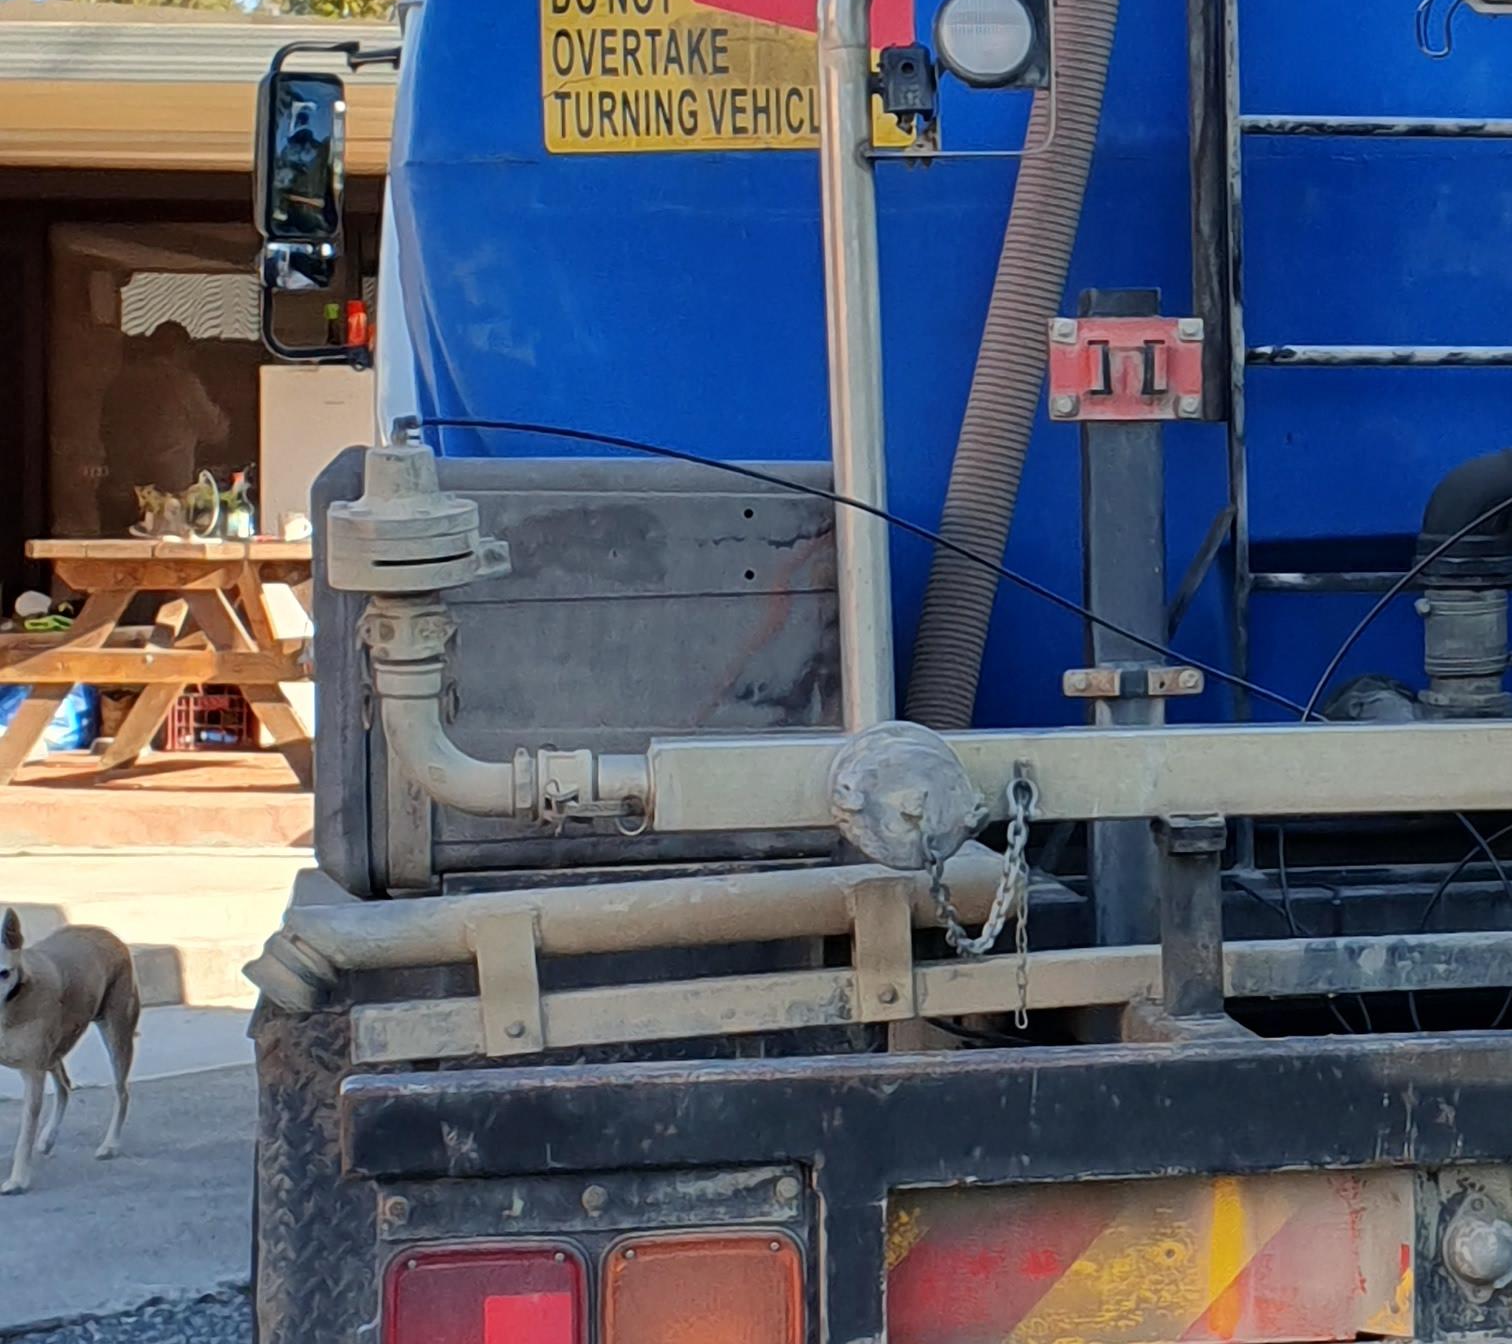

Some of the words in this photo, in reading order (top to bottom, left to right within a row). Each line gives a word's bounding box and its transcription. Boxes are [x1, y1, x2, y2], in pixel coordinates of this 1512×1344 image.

[552, 27, 730, 77] OVERTAKE
[554, 87, 699, 138] TURNING
[707, 87, 820, 135] VEHICL
